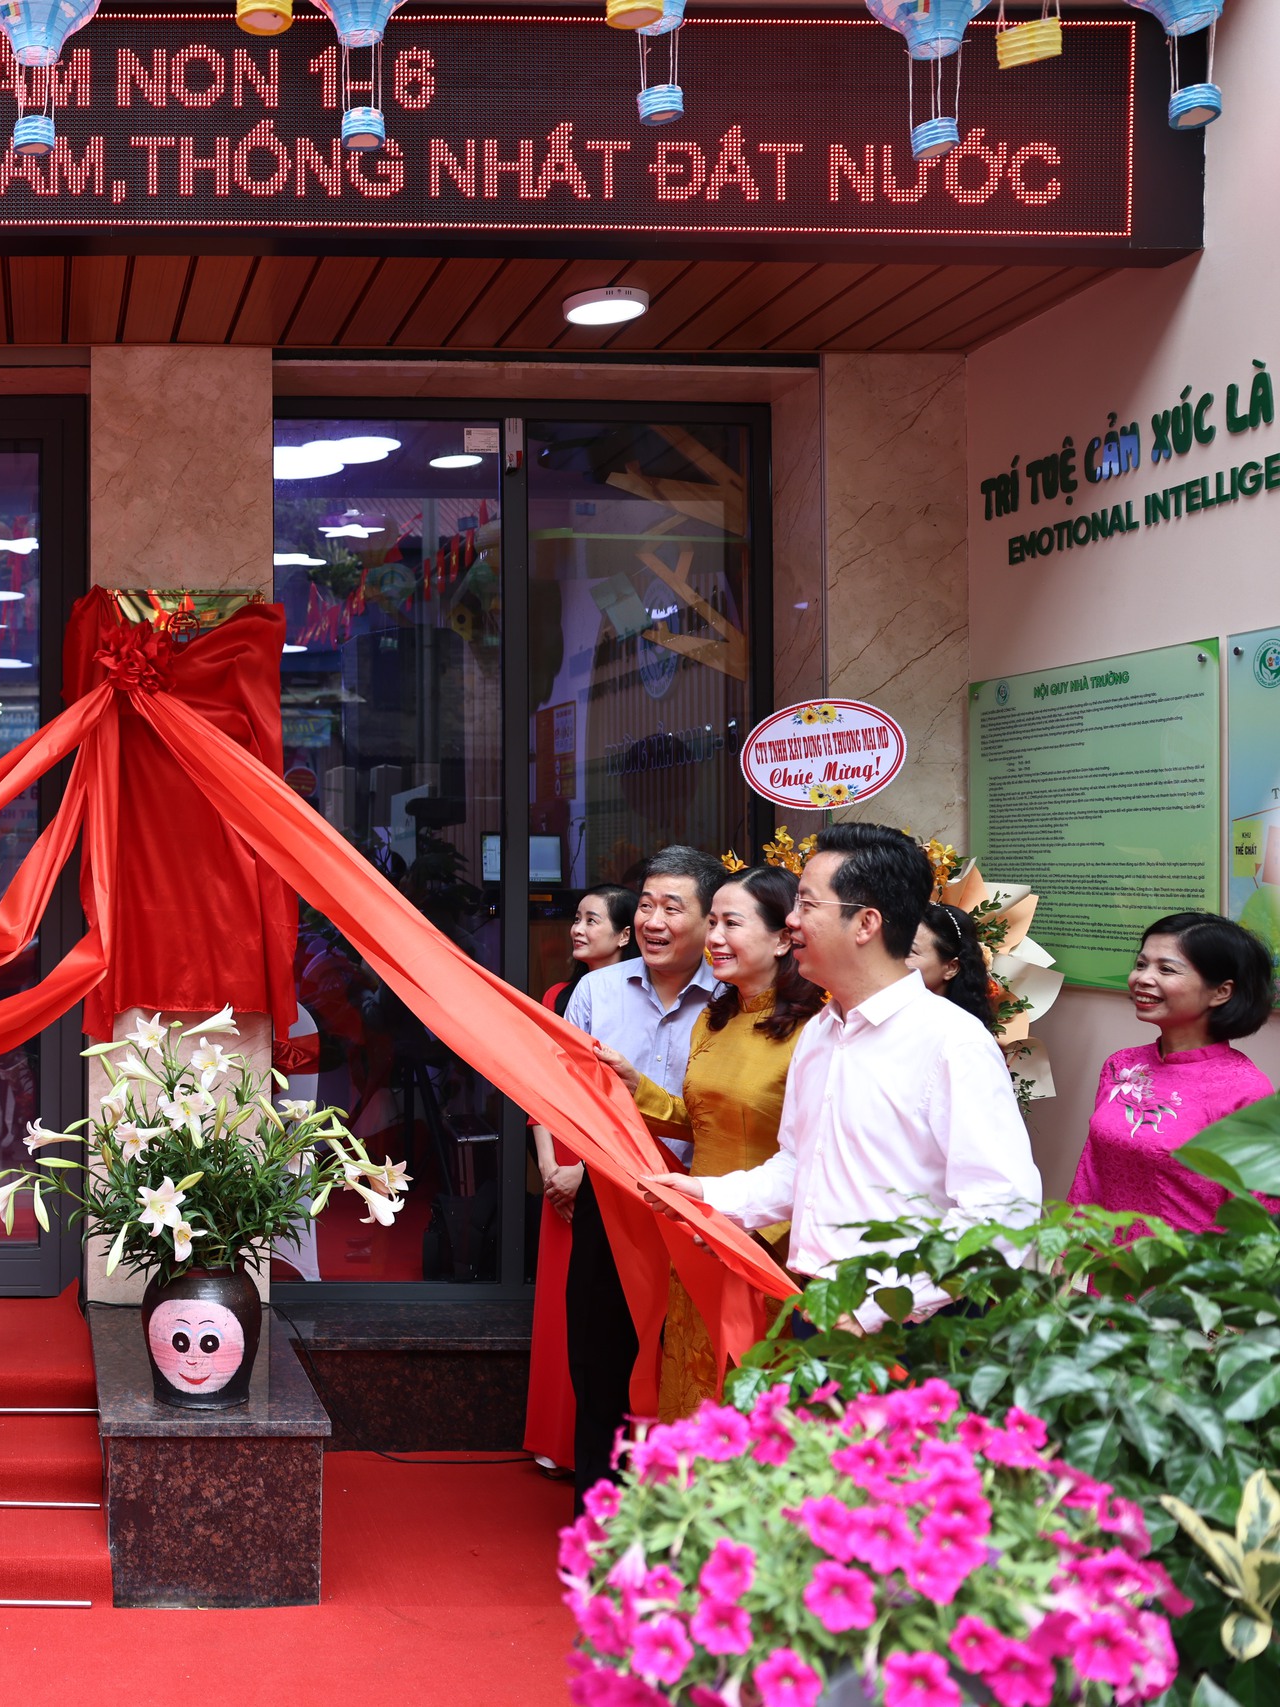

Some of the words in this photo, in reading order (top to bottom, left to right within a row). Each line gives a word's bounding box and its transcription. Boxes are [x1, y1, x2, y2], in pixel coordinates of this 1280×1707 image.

[117, 43, 279, 107] NON
[431, 122, 631, 200] NHẤT
[830, 127, 1062, 205] NƯỚC
[980, 454, 1020, 521] TRÍ
[1026, 435, 1078, 506] TUỆ
[1084, 411, 1141, 484] CẢM
[1151, 384, 1217, 464] XÚC
[1226, 358, 1275, 434] LÀ
[1008, 500, 1140, 566] EMOTIONAL
[1033, 682, 1049, 701] NỘI
[1050, 681, 1070, 696] QUY
[1070, 675, 1089, 693] NHÀ
[1089, 670, 1130, 690] TRƯỜNG
[755, 741, 768, 765] CTY
[768, 739, 788, 763] TNHH
[769, 767, 814, 789] Chúc
